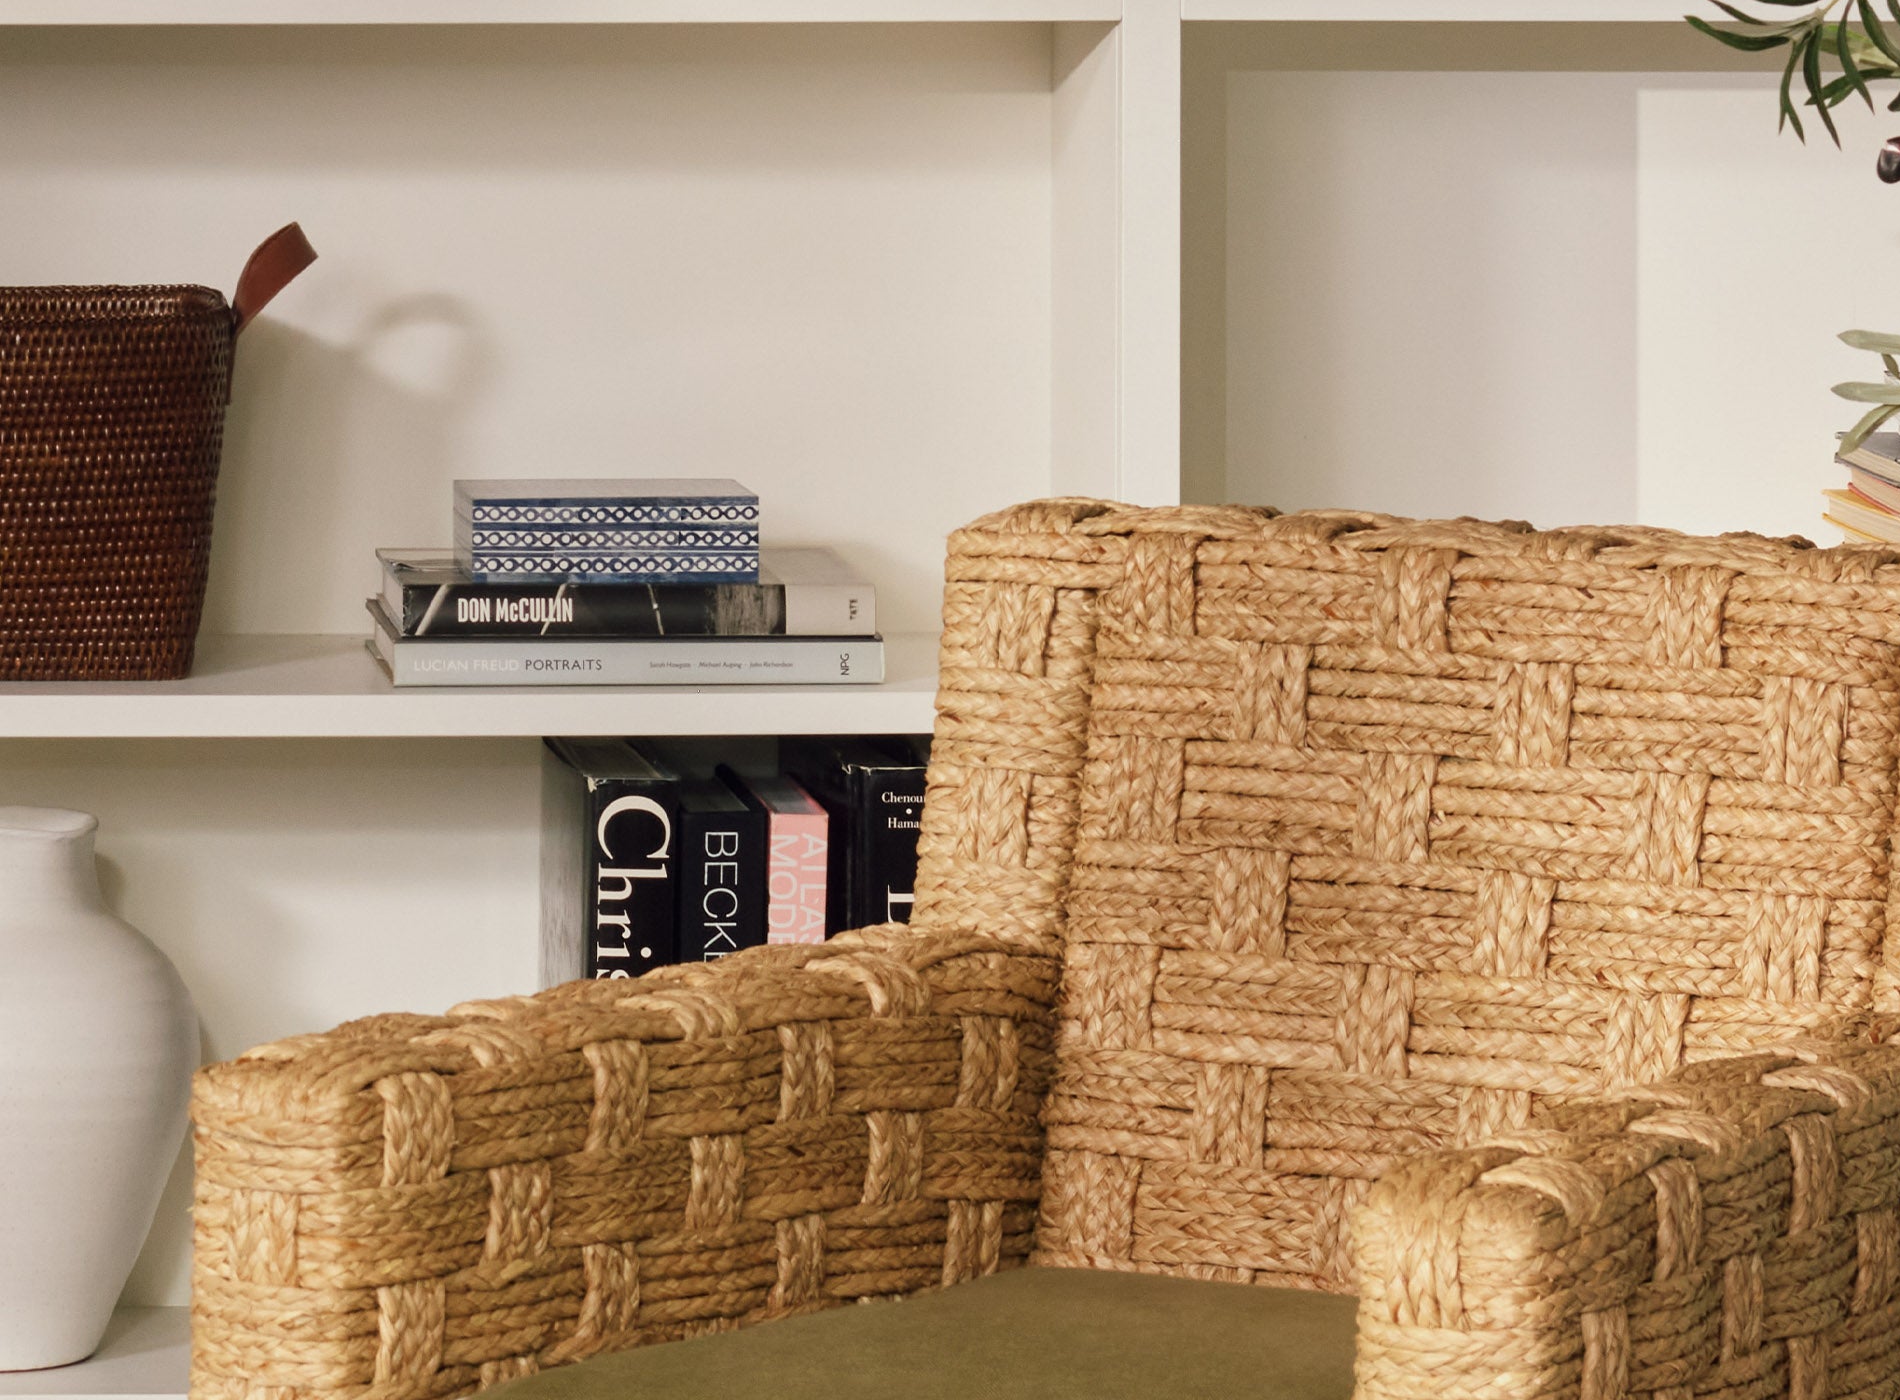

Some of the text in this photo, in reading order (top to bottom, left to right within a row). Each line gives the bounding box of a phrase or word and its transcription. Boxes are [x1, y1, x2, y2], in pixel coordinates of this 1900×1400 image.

[458, 598, 573, 622] DON McCULLIN
[414, 659, 602, 672] LUCIAN FREUD PORTRAITS
[840, 653, 849, 676] NPG
[881, 792, 926, 804] Chenou
[888, 817, 919, 829] Hama
